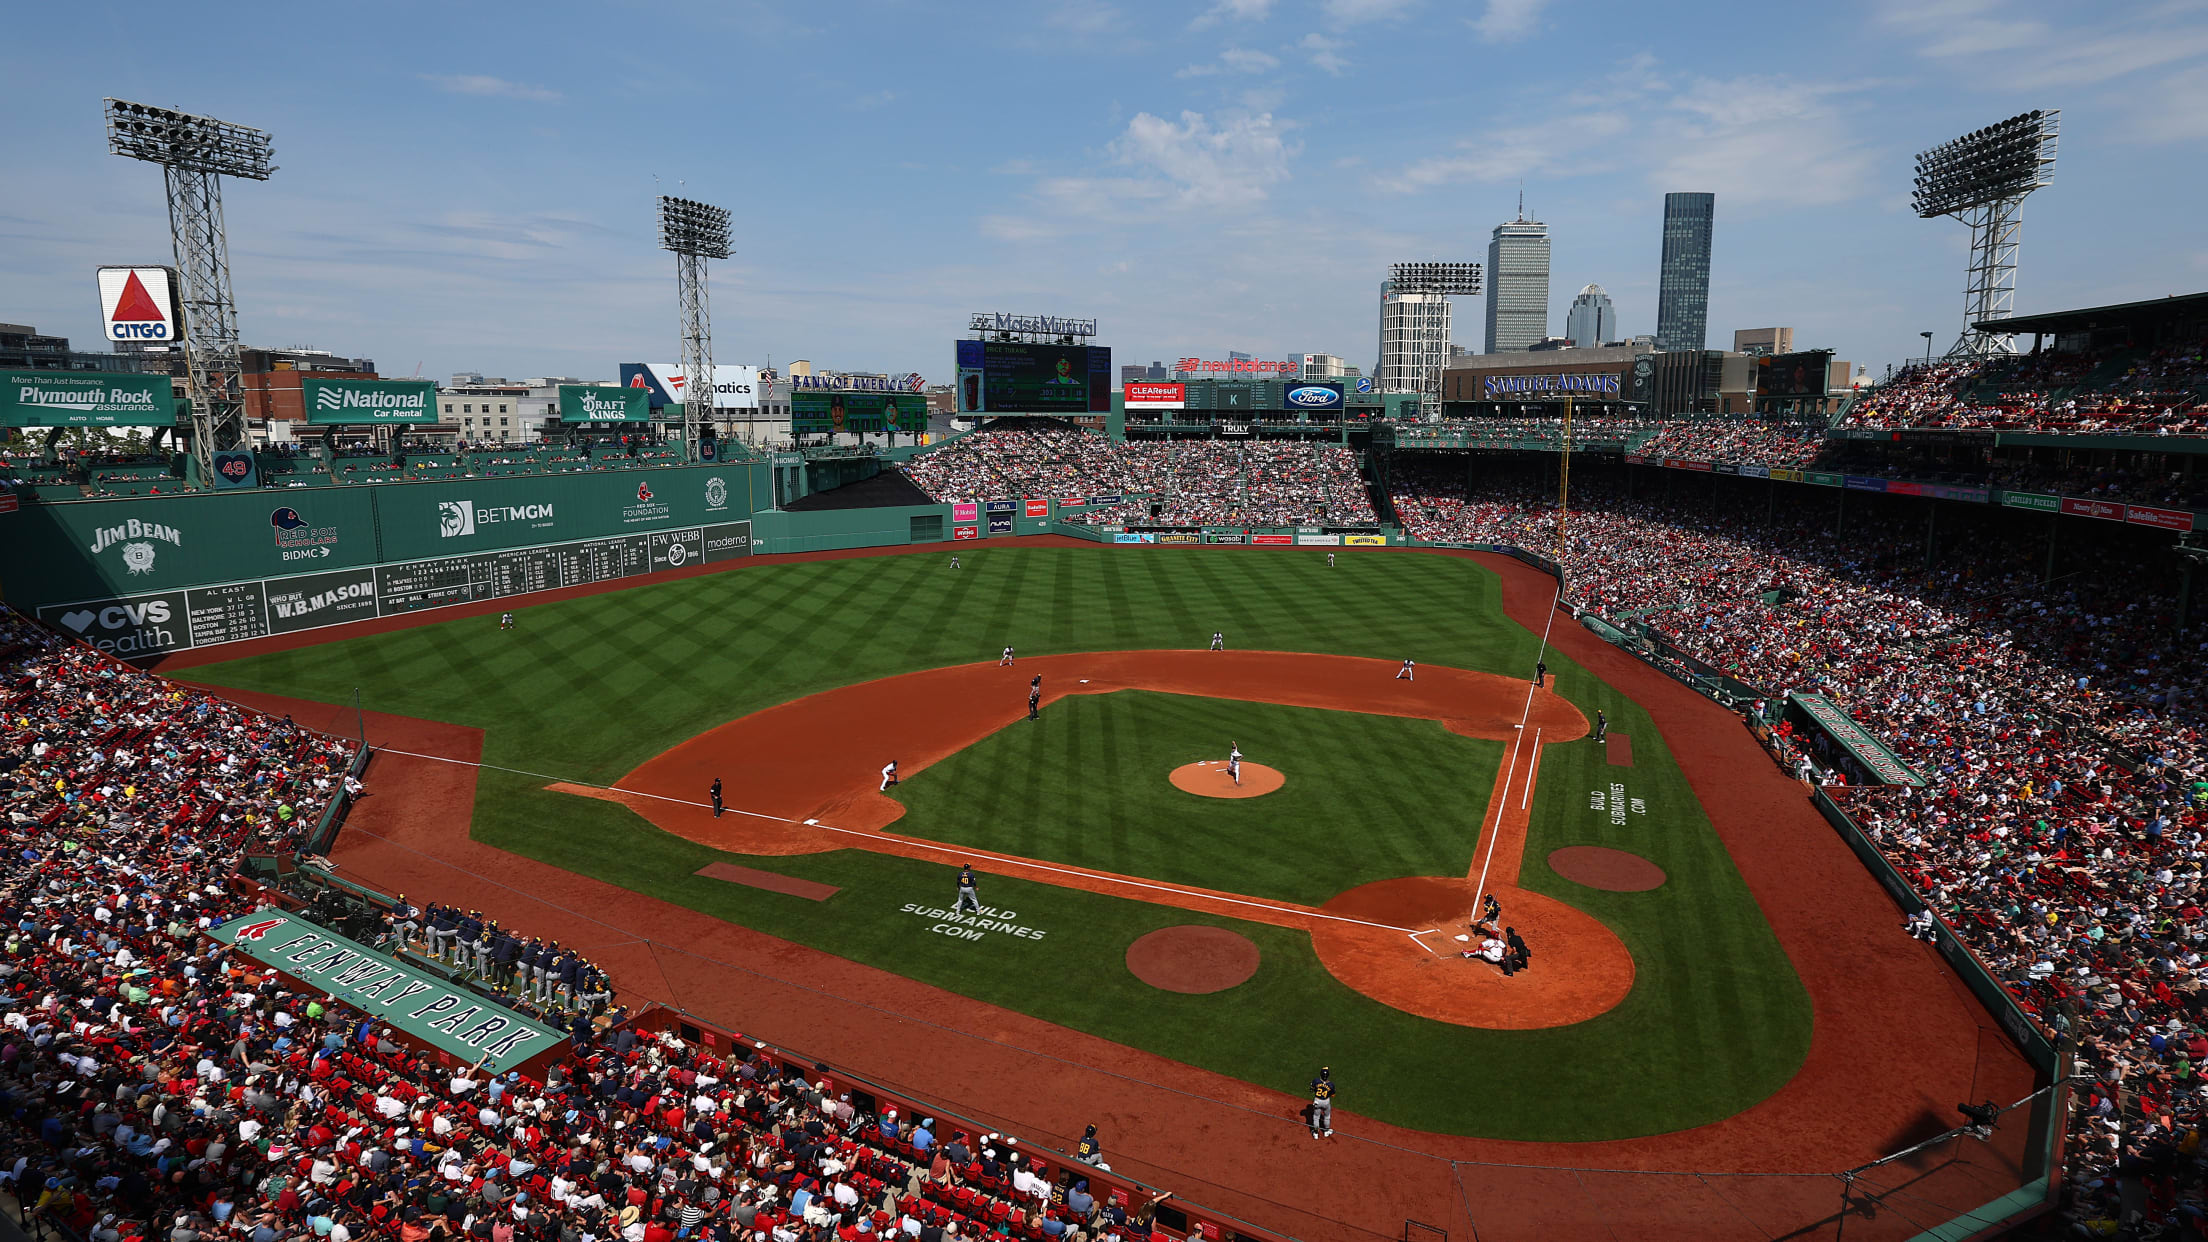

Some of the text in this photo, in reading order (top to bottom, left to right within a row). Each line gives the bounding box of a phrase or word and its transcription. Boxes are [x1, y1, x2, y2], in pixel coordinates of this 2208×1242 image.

[995, 312, 1096, 336] MassMutual
[113, 323, 166, 338] CITGO
[11, 376, 32, 384] More
[792, 375, 903, 391] BANK OF AMERICA
[1484, 373, 1619, 395] SAMUEL ADAMS
[19, 387, 152, 405] Plymouth Rock
[1230, 394, 1237, 405] K
[1299, 391, 1328, 402] Ford
[583, 401, 626, 412] DRAFT
[589, 410, 625, 419] KINGS
[704, 446, 713, 455] LL
[222, 461, 247, 476] 49
[2034, 498, 2057, 508] PICKLES
[2073, 503, 2113, 514] Ninety Nine
[477, 504, 553, 524] BETMGM
[623, 507, 669, 517] FOUNDATION
[2128, 509, 2158, 522] Safelite
[91, 519, 182, 553] JIM BEAM
[280, 527, 337, 539] RED SOX
[672, 531, 700, 542] WEBB
[281, 536, 338, 548] SCHOLARS
[708, 536, 747, 549] moderna
[282, 549, 319, 561] BIDMC
[400, 562, 437, 571] FENWAY
[222, 586, 245, 594] EAST
[269, 592, 303, 604] WHO BUT
[99, 600, 171, 629] CVS
[192, 614, 225, 623] BALTIMORE
[193, 622, 218, 631] BOSTON
[194, 630, 214, 638] TAMPA
[195, 636, 225, 645] TORONTO
[1591, 791, 1605, 811] BUILD
[1610, 782, 1626, 826] SUBMARINES
[1630, 798, 1646, 815] .COM
[900, 903, 1048, 940] SUBMARINES
[925, 923, 985, 942] .COM
[269, 932, 541, 1059] FENWAY PARK
[1316, 1088, 1328, 1098] 24
[1079, 1142, 1090, 1155] 88
[1052, 1192, 1062, 1204] 22
